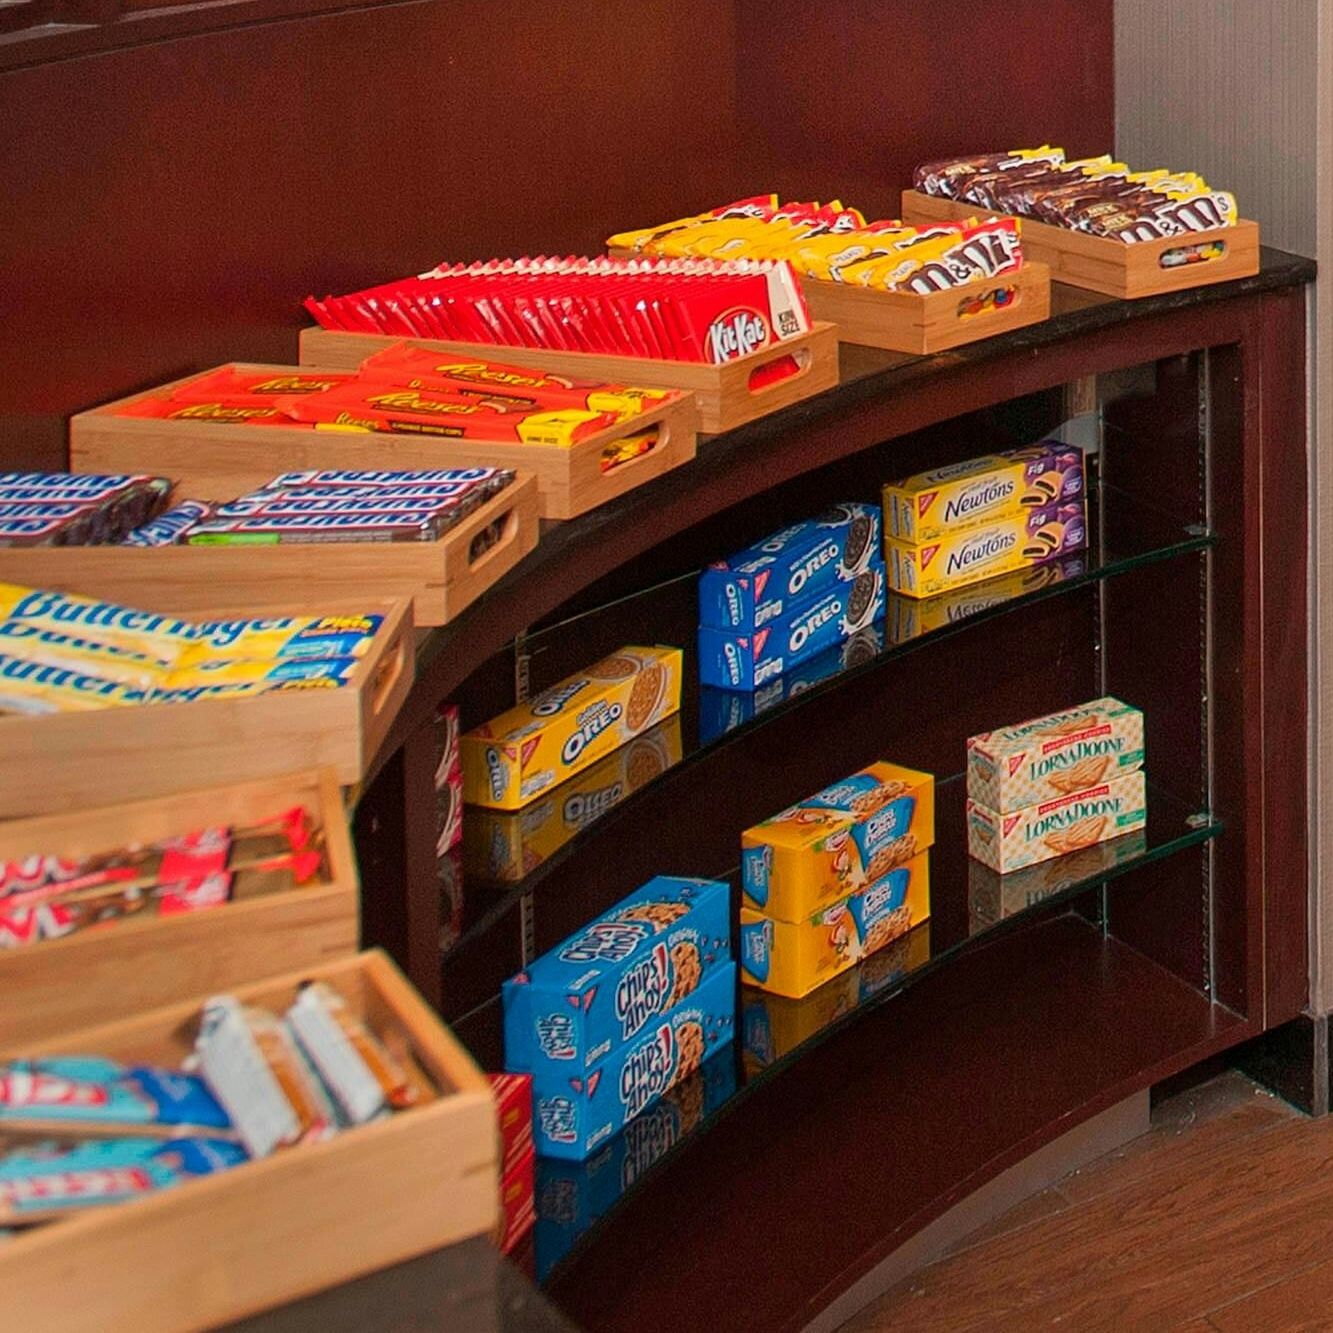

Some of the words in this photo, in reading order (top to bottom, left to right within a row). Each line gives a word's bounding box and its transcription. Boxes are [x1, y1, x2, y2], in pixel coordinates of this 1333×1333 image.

[781, 320, 801, 334] SIZE
[1028, 463, 1044, 475] Fig
[945, 480, 1014, 523] Newtons
[1030, 515, 1046, 527] Fig
[788, 544, 839, 595] OREO
[947, 530, 1016, 575] Newtons
[725, 583, 740, 626] OREO
[789, 600, 842, 652] OREO
[724, 642, 740, 685] OREO
[563, 702, 622, 764] OREO
[1031, 747, 1076, 781] LORNA
[1076, 737, 1125, 758] DOONE
[1025, 808, 1073, 842] LORNA
[1074, 798, 1124, 817] DOONE
[617, 953, 659, 1016] Chips
[621, 1034, 664, 1098] Chips
